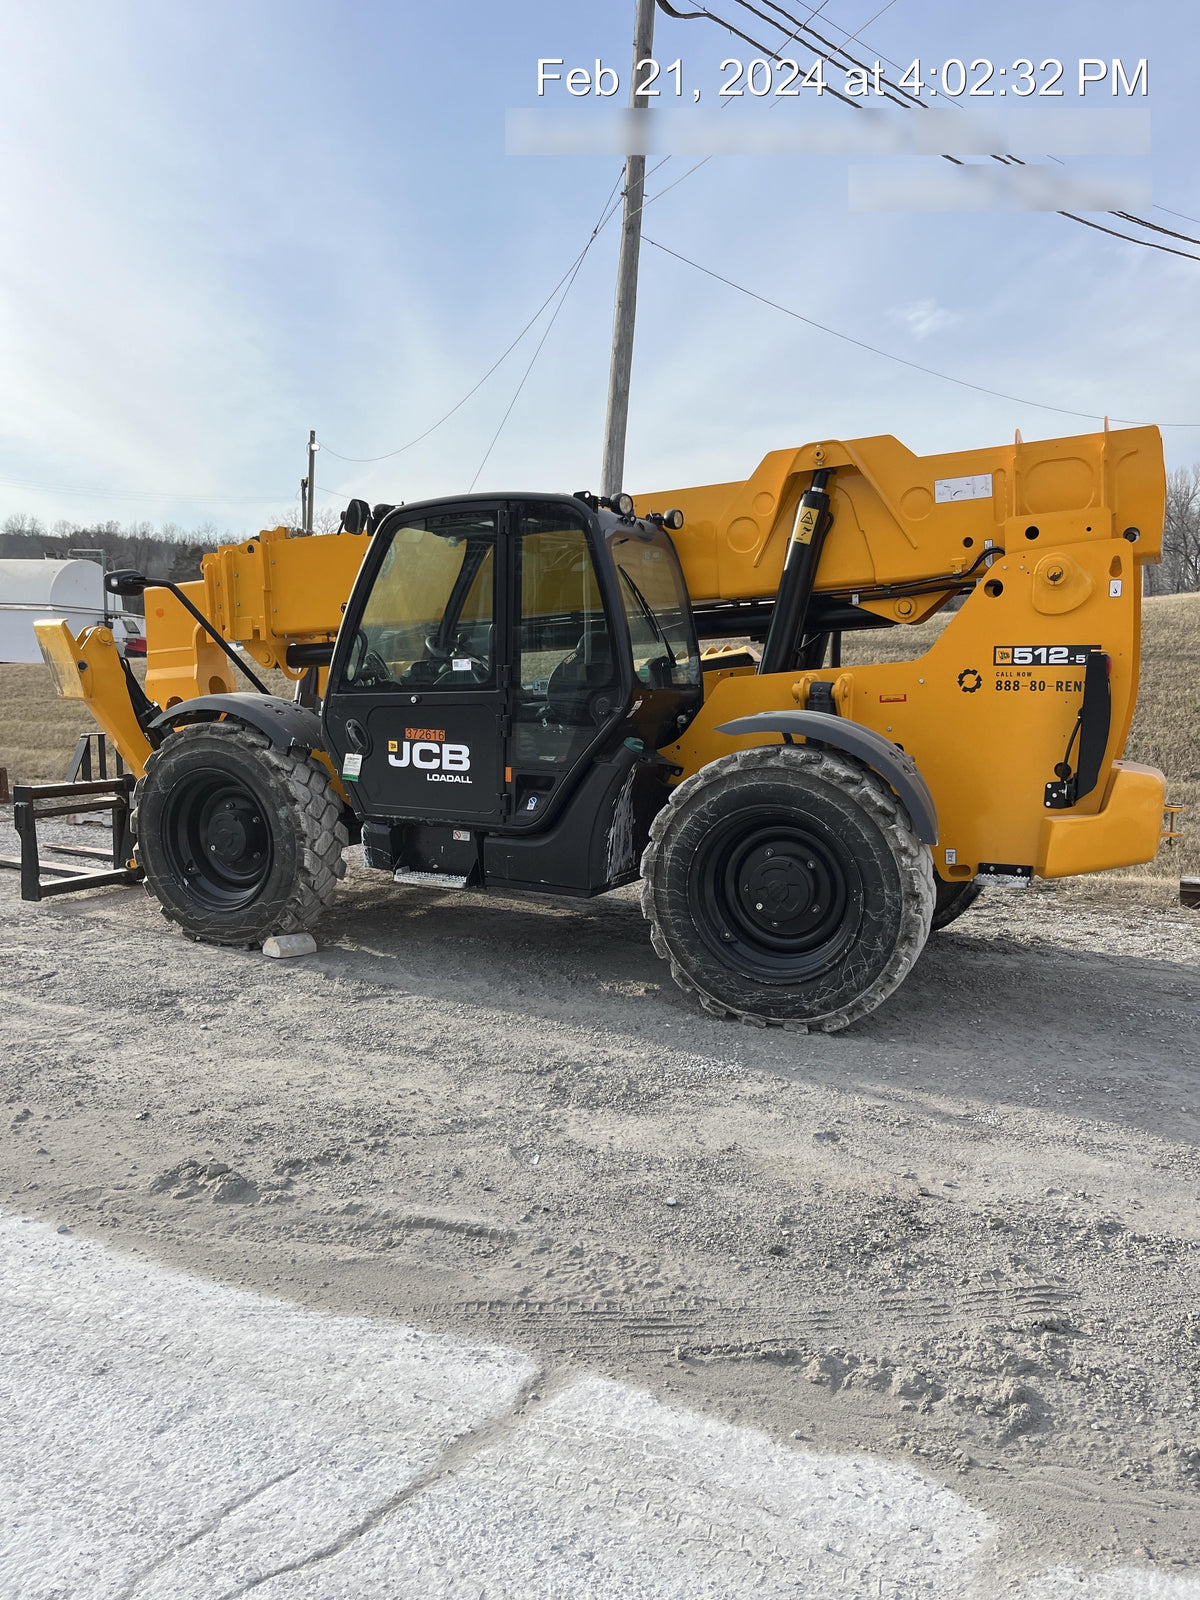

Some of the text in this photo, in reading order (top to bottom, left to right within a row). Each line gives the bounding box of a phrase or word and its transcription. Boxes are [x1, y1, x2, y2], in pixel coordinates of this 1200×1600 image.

[1013, 647, 1087, 664] 512-5
[995, 680, 1085, 692] 888-80-REN
[406, 729, 445, 741] 372616
[388, 741, 471, 771] JCB
[426, 773, 472, 783] LOADALL
